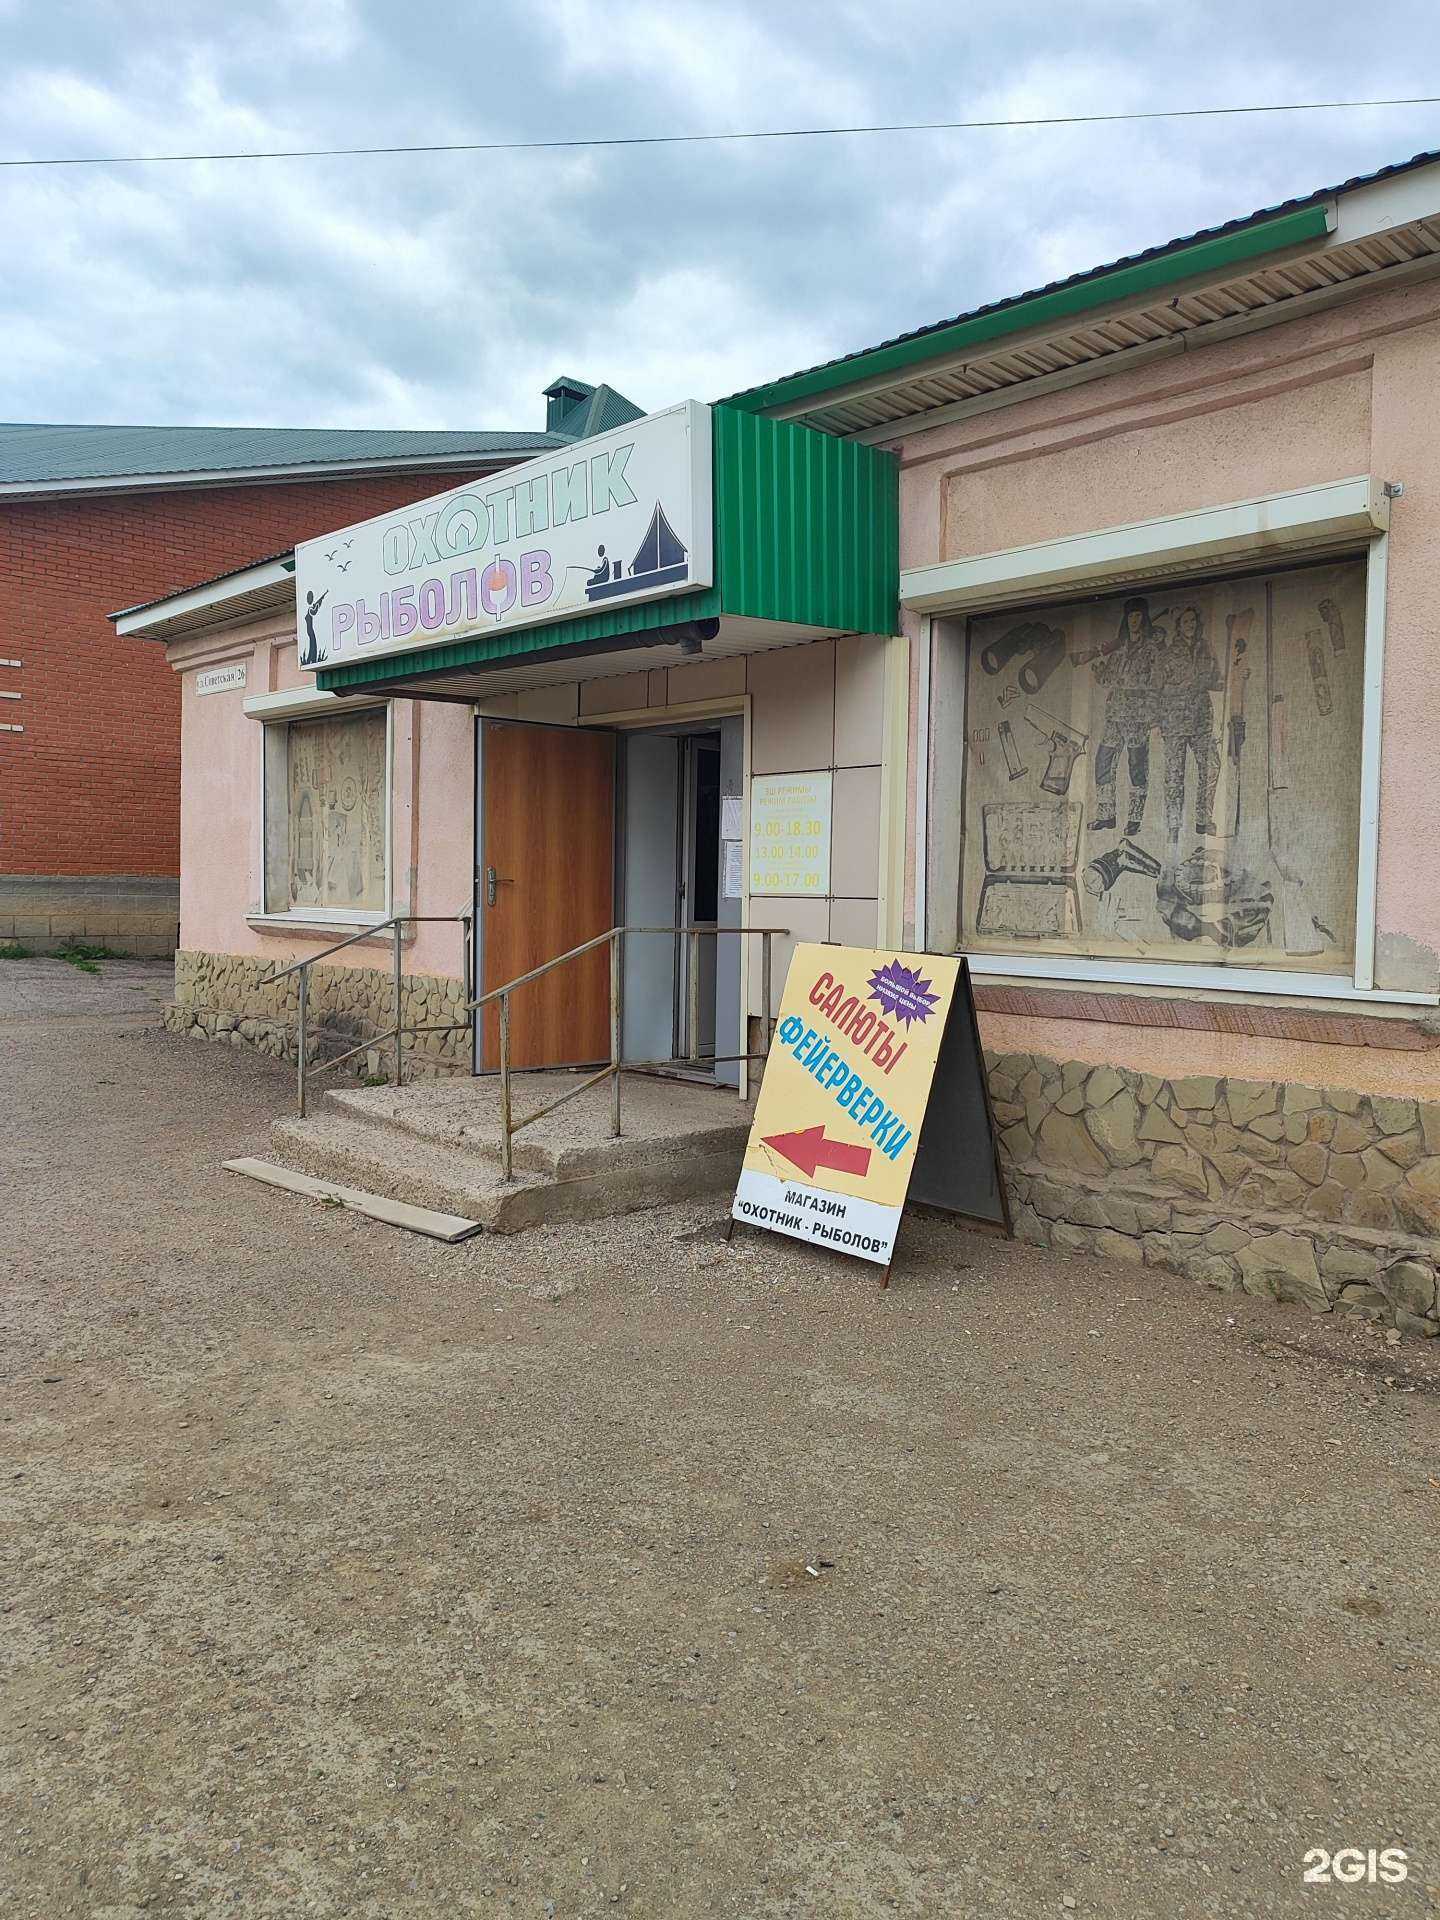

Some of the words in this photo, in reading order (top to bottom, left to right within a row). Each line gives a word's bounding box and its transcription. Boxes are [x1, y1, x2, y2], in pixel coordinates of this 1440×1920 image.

[382, 443, 639, 576] ОХОТНИК
[331, 550, 554, 651] РЫБОЛОВ
[237, 669, 246, 681] 26
[808, 972, 909, 1076] САЛЮТЫ
[899, 997, 917, 1011] ЦЕНЫ
[778, 1015, 912, 1162] ФЕЙЕРВЕРКИ
[784, 1190, 847, 1219] МАГАЗИН
